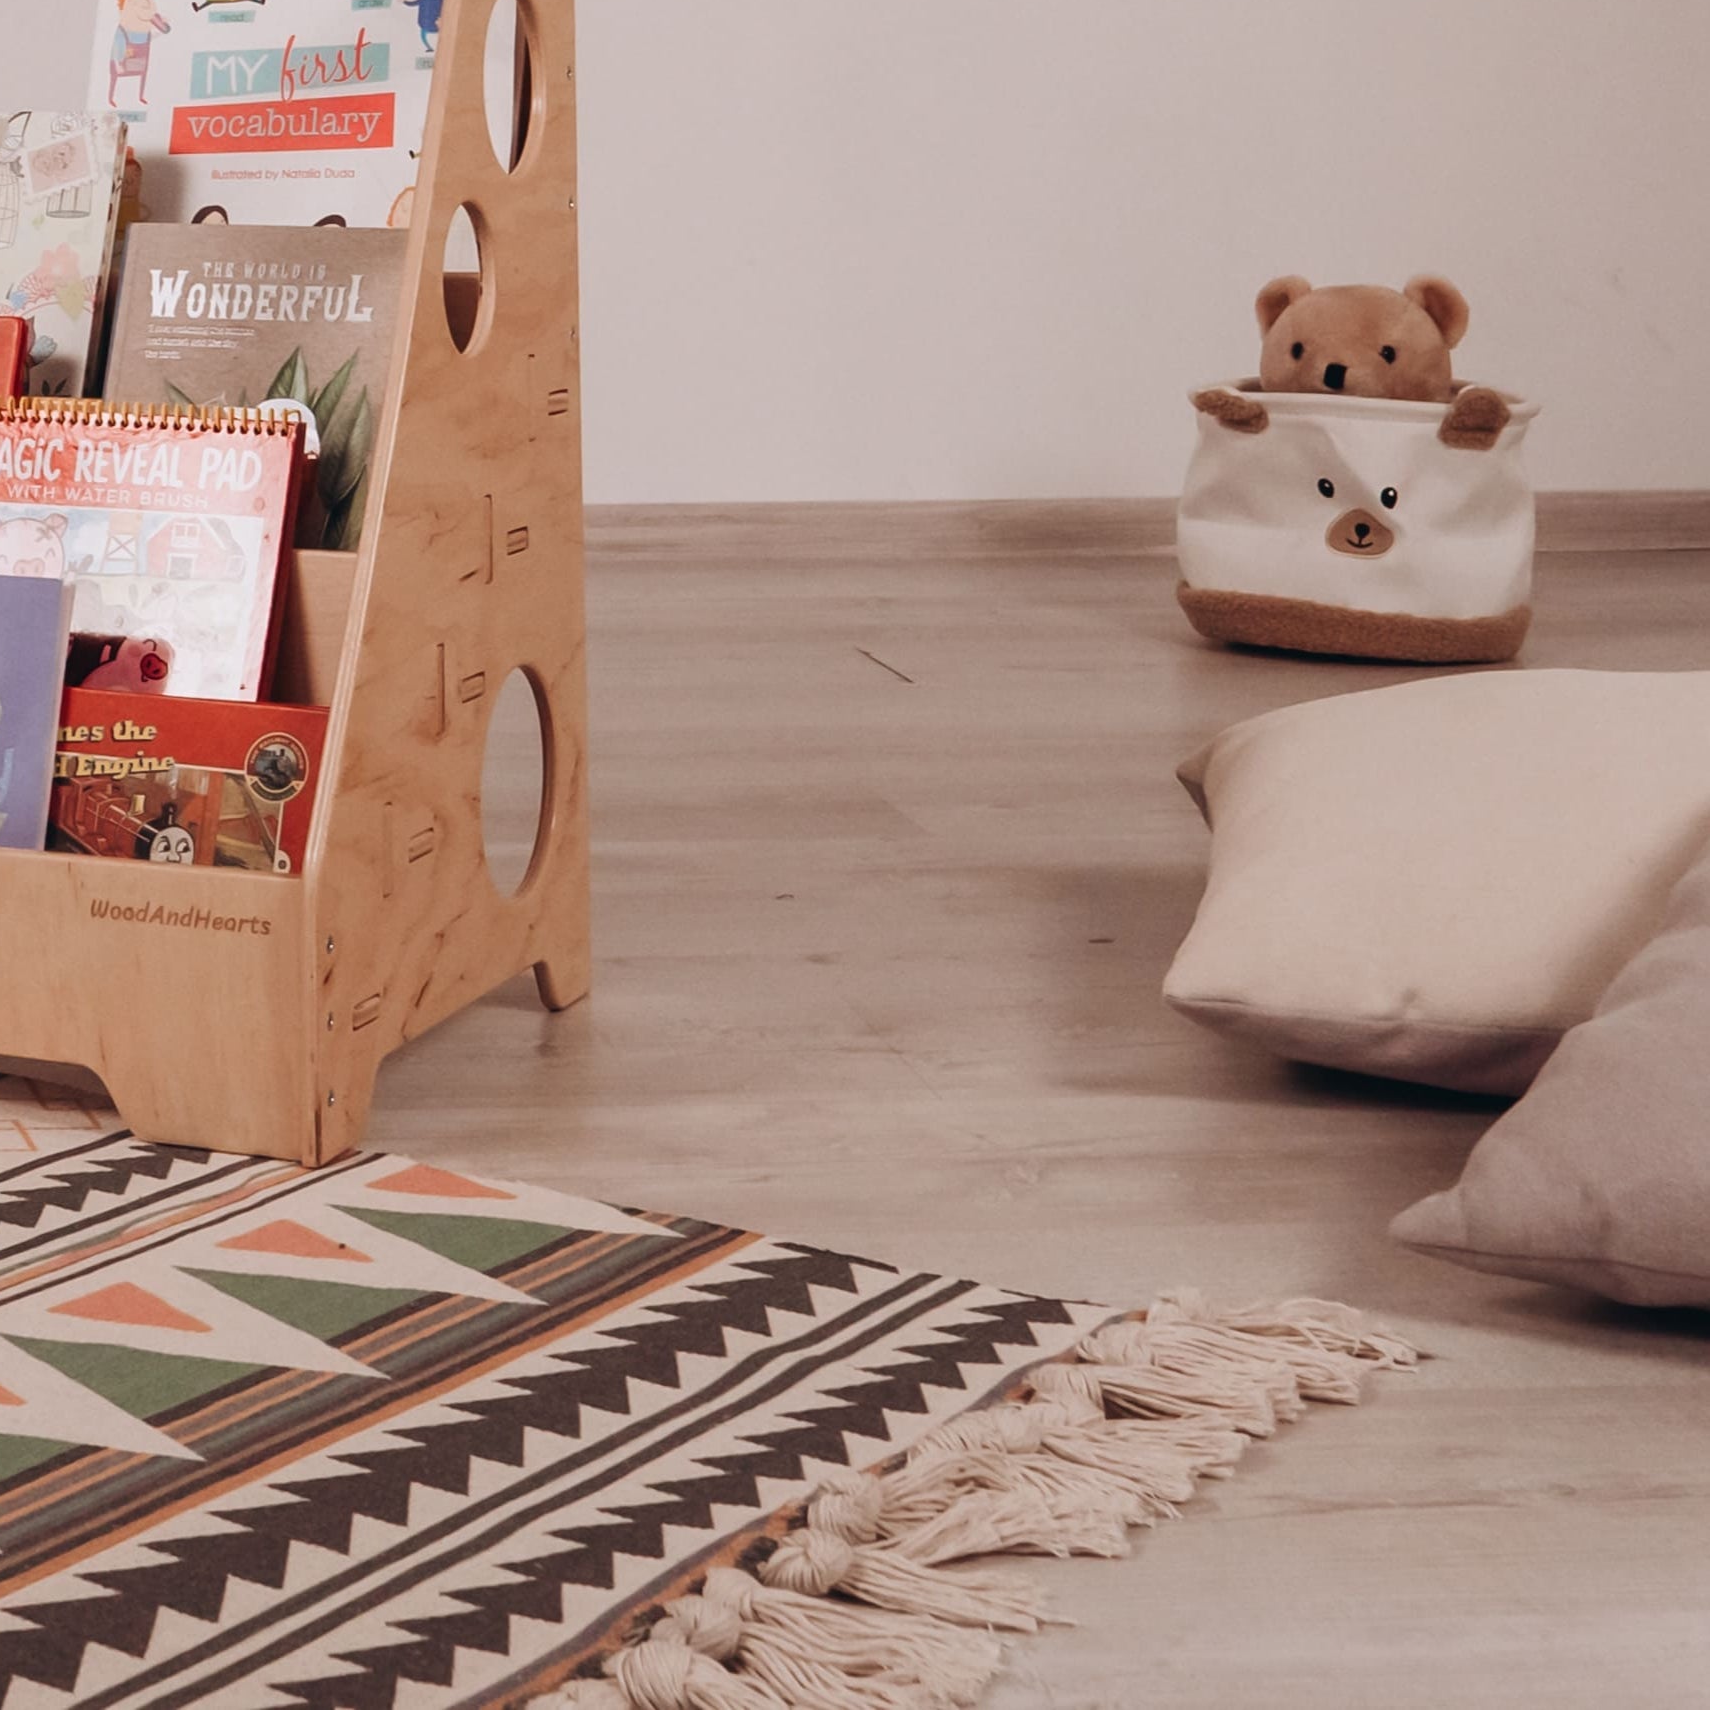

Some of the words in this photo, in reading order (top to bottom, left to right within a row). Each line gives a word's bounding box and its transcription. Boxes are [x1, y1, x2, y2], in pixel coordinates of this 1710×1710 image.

[206, 53, 269, 94] MY
[280, 27, 375, 103] first
[187, 107, 383, 142] vocabulary
[265, 169, 279, 181] by
[202, 261, 235, 279] THE
[243, 261, 302, 281] WORLD
[308, 264, 327, 282] IS
[74, 439, 184, 488] REVEAL
[198, 447, 263, 493] PAD
[6, 484, 56, 500] WITH
[64, 487, 131, 505] WATER
[140, 492, 209, 509] BRUSH
[112, 719, 158, 741] the
[75, 749, 175, 780] Engine
[90, 898, 272, 936] WoodAndHearts
